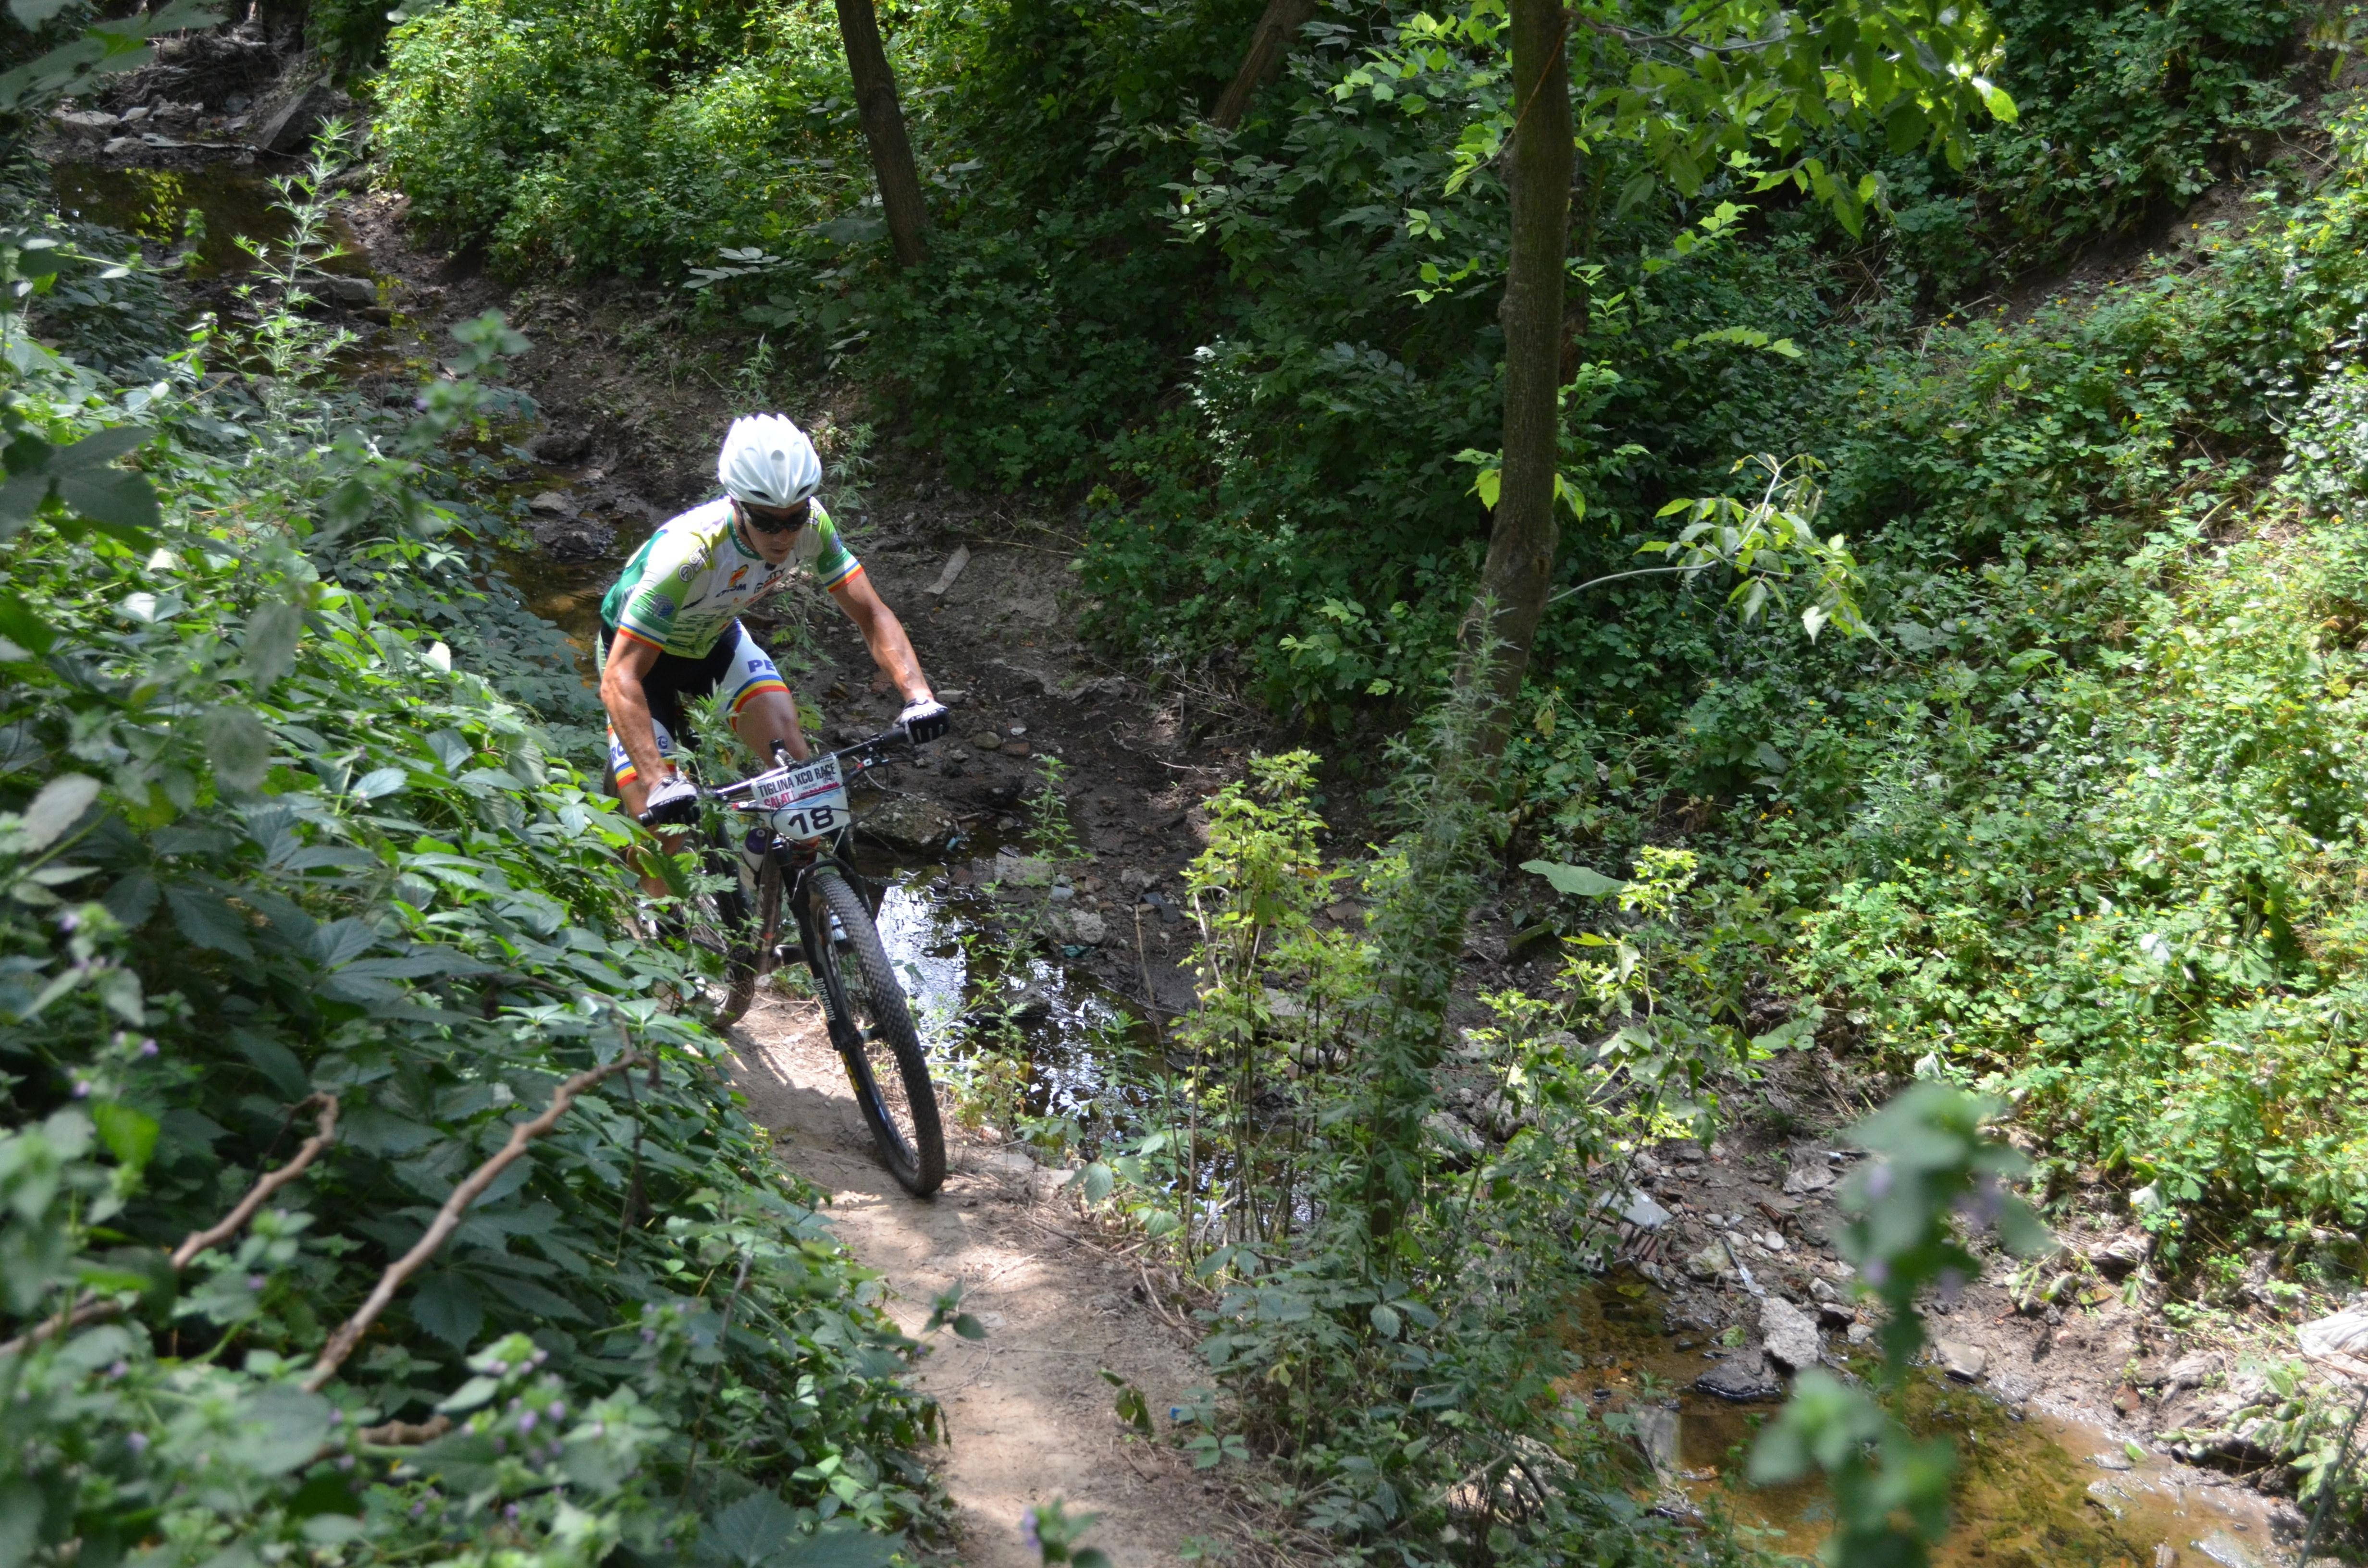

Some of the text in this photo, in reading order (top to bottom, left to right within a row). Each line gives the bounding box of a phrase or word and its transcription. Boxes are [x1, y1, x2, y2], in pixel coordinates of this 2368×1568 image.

[757, 775, 795, 797] TIGLINA
[795, 770, 814, 786] XCO
[814, 763, 836, 780] RACE
[788, 805, 834, 835] 18
